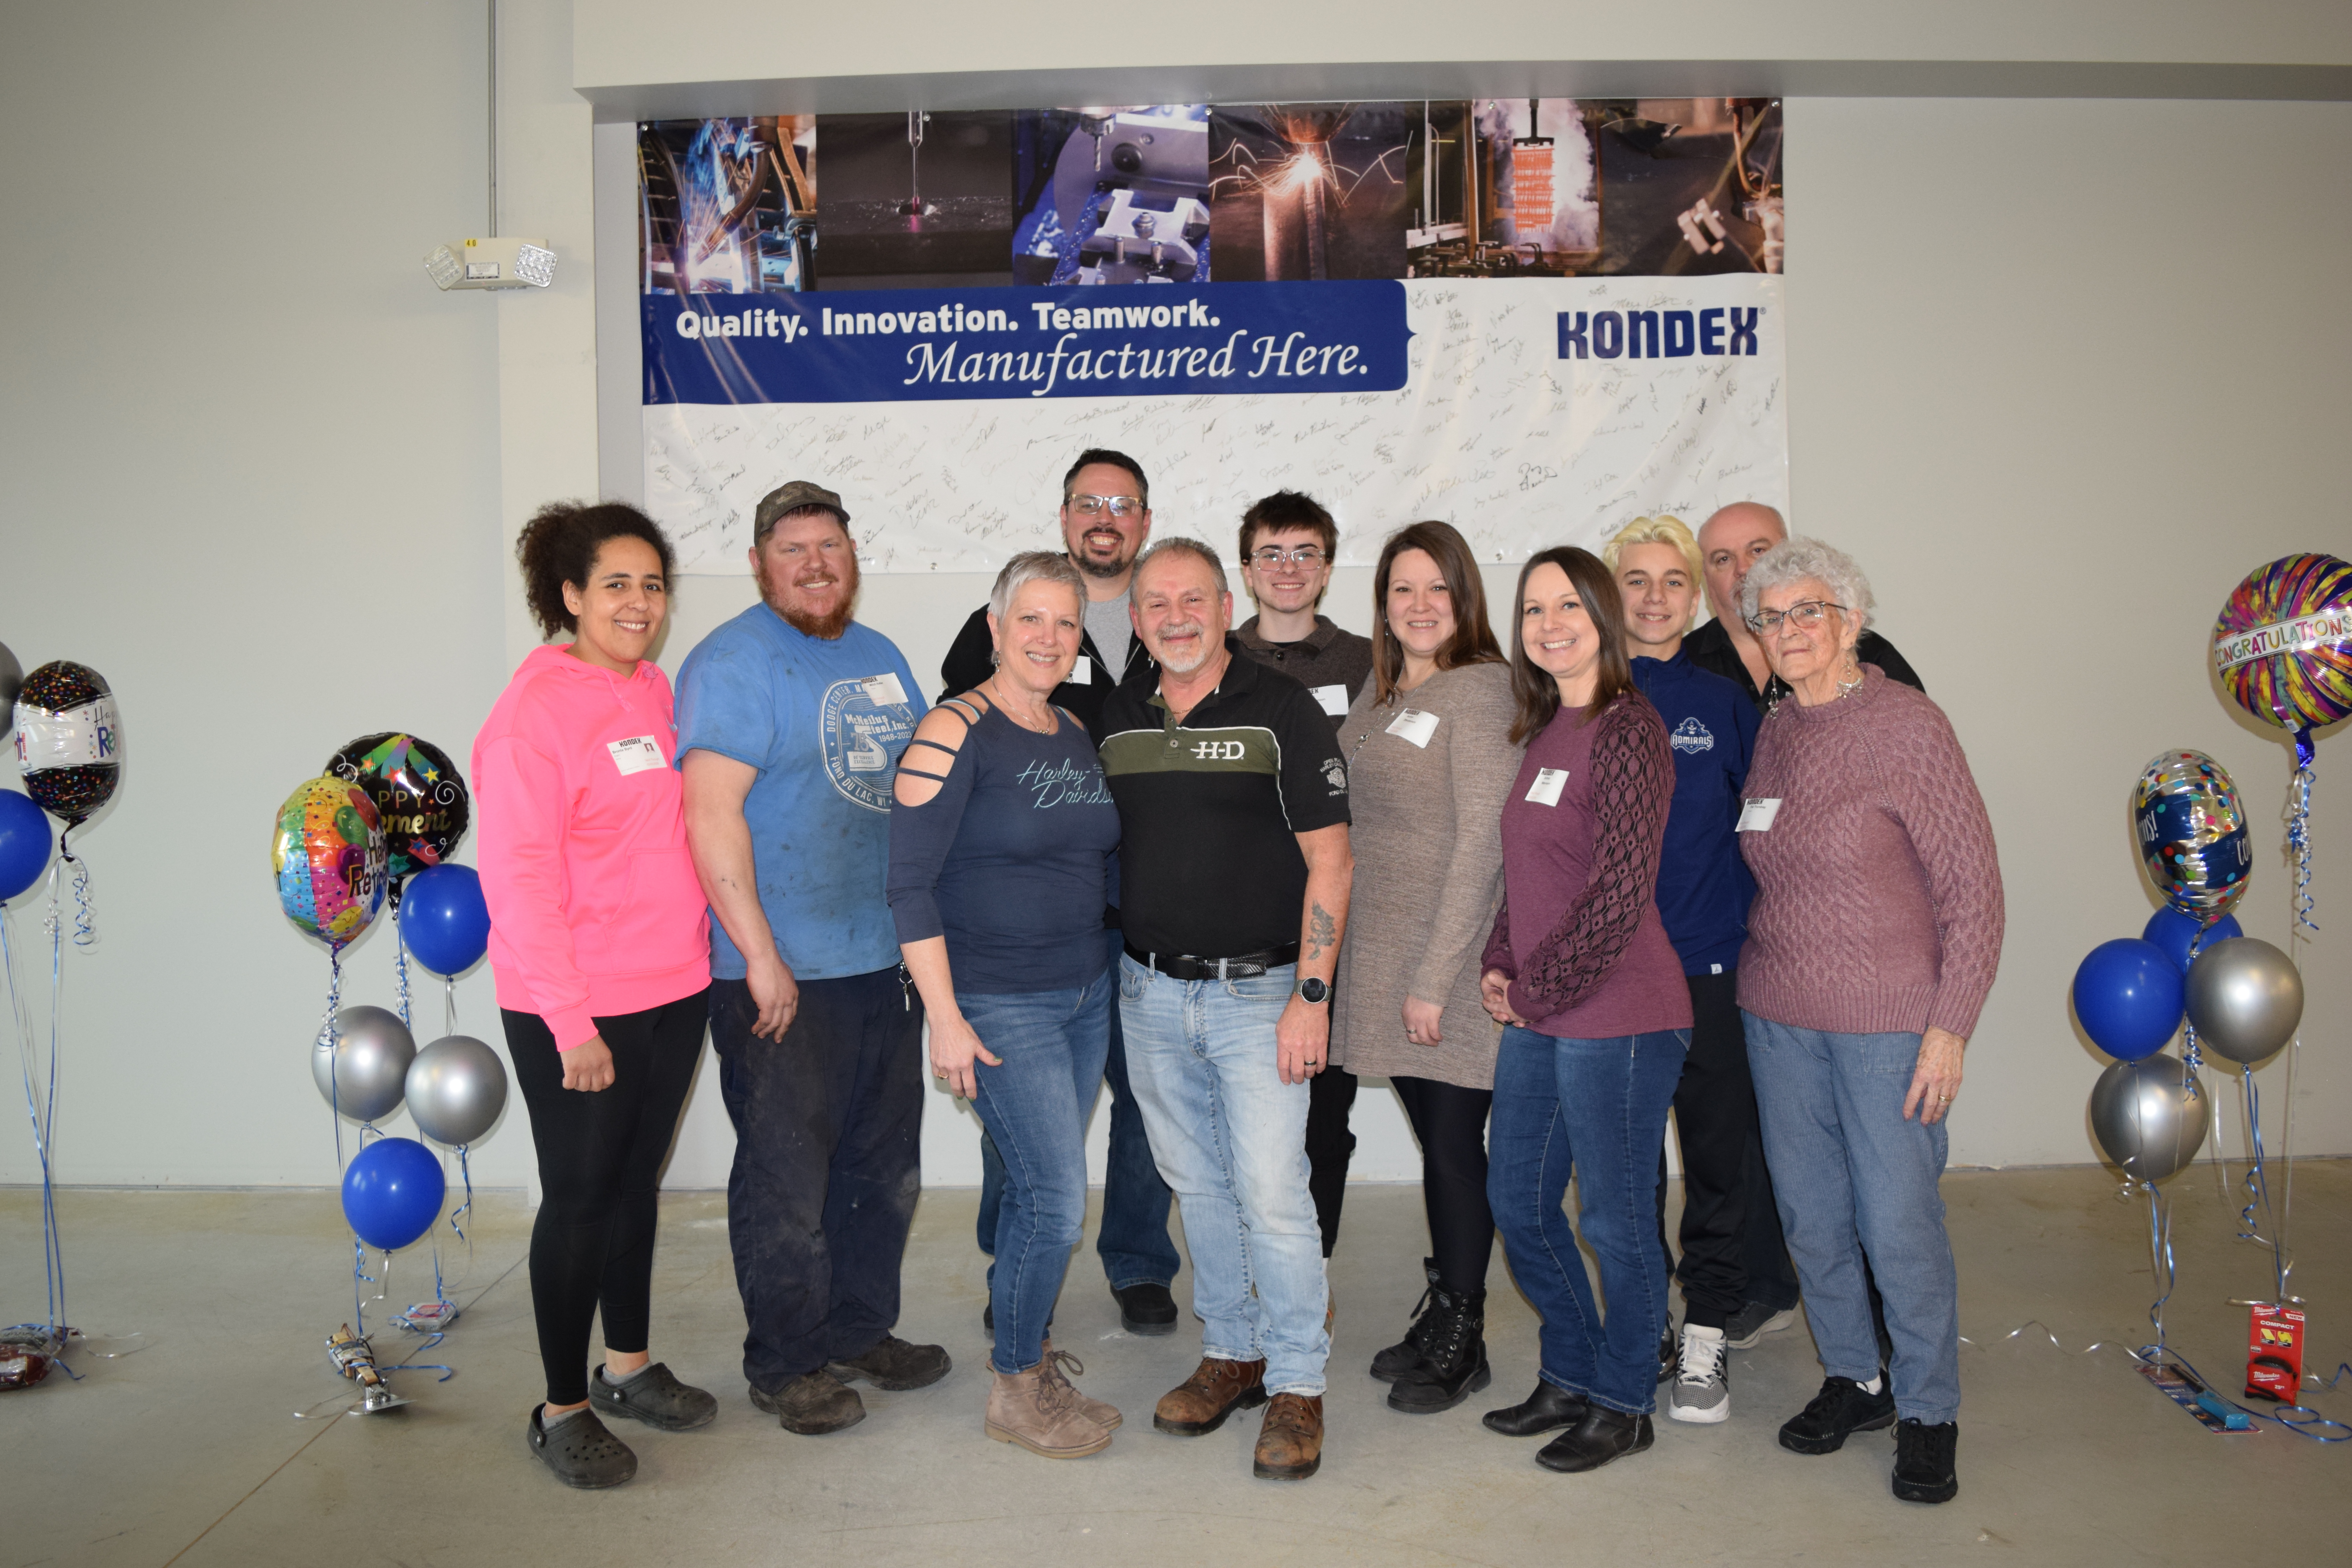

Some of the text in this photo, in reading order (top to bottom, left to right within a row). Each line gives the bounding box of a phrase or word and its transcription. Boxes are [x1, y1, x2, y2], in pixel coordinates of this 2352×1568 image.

[677, 298, 1220, 343] Quality. Innovation. Teamwork.
[1557, 307, 1758, 359] KONDEX
[903, 329, 1247, 396] Manufactured
[1247, 332, 1368, 377] Here.
[2216, 614, 2352, 666] CONGRATULATIONS
[827, 703, 837, 732] DODGE
[844, 714, 888, 725] McNeilus
[619, 738, 642, 747] KONDEX
[851, 732, 869, 751] 75
[879, 731, 912, 742] 1948-2023
[1672, 734, 1712, 748] ADMIRALS
[830, 757, 845, 780] FOND
[842, 777, 856, 791] DU
[877, 796, 886, 806] WI
[378, 790, 426, 809] PPY
[2260, 1320, 2295, 1330] COMPACT
